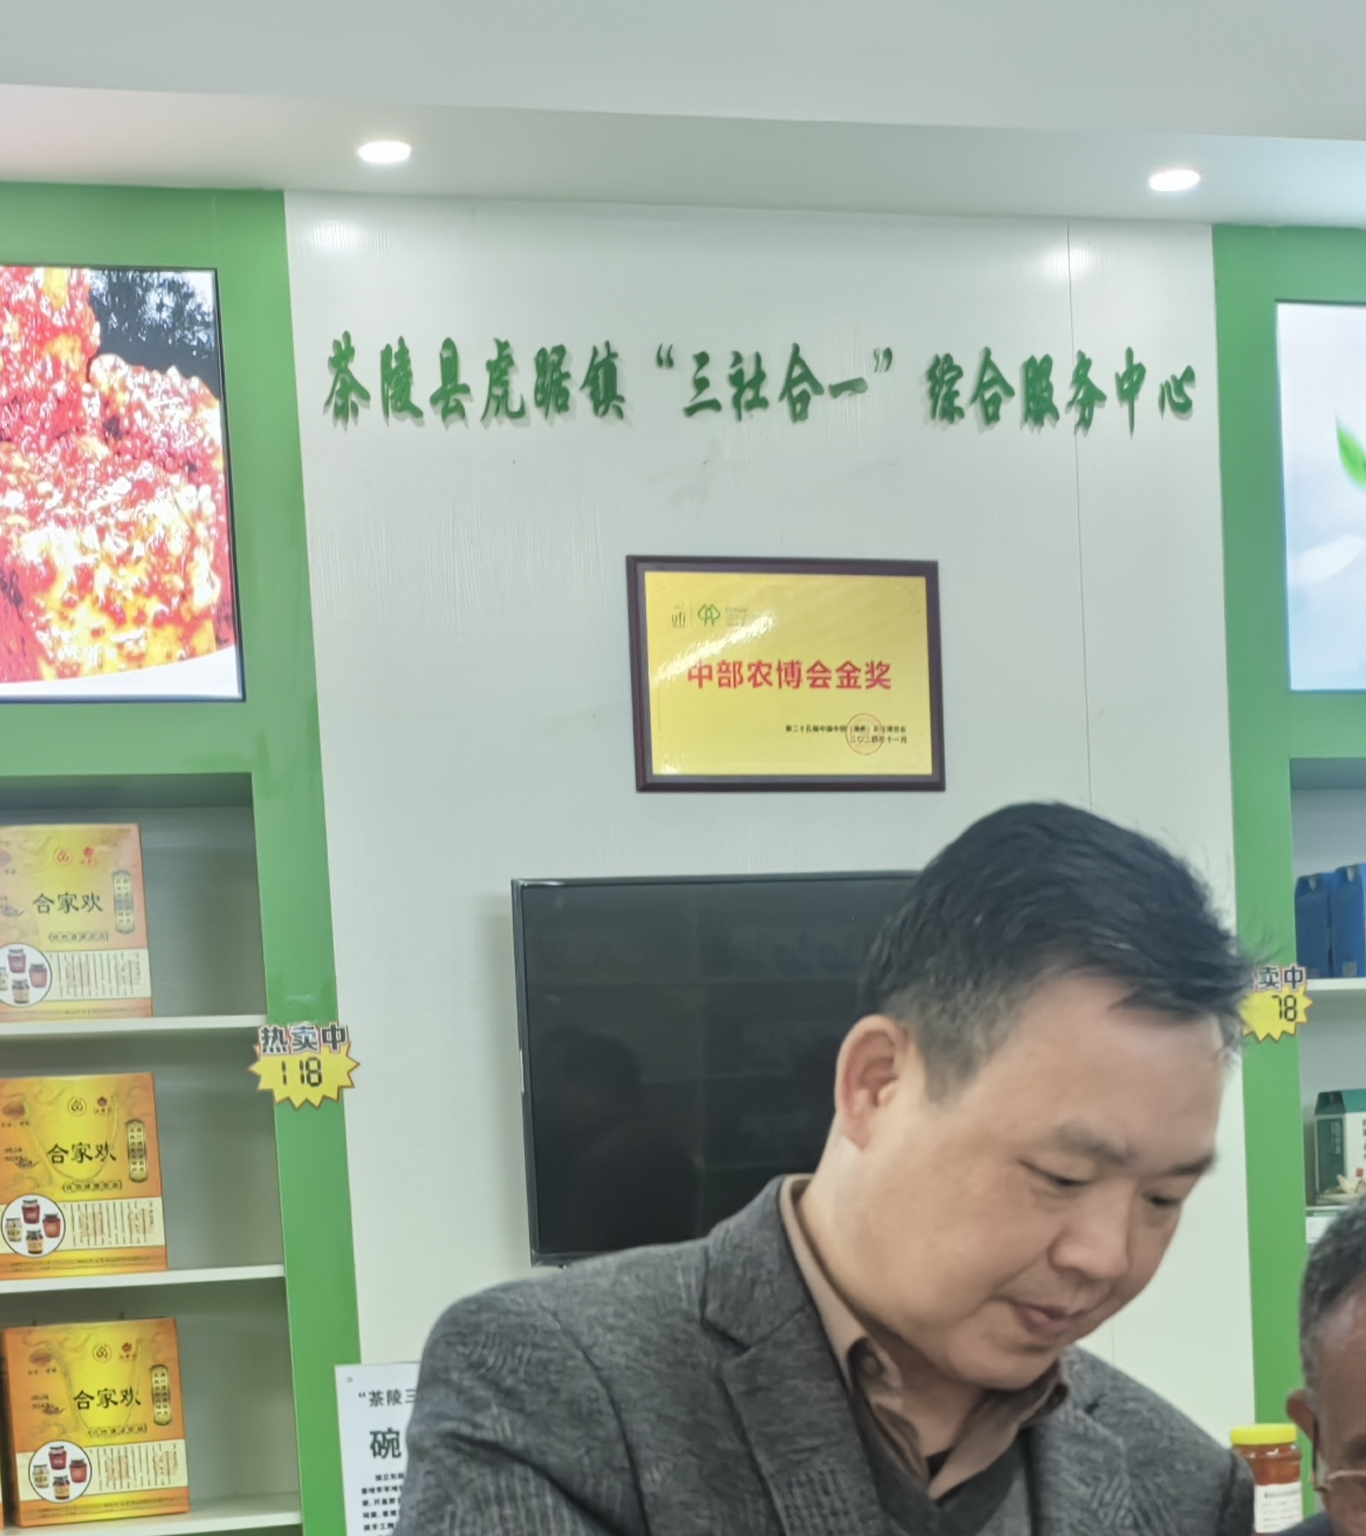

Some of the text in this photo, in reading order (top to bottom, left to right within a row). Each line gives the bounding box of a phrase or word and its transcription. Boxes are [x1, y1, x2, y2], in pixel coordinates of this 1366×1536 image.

[687, 659, 892, 691] 中部农博会金奖
[32, 893, 104, 917] 合家欢
[1258, 965, 1304, 989] 卖中
[260, 1024, 346, 1053] 热卖中
[46, 1141, 118, 1165] 合家欢
[73, 1386, 142, 1410] 合家欢
[369, 1428, 402, 1459] 碗
